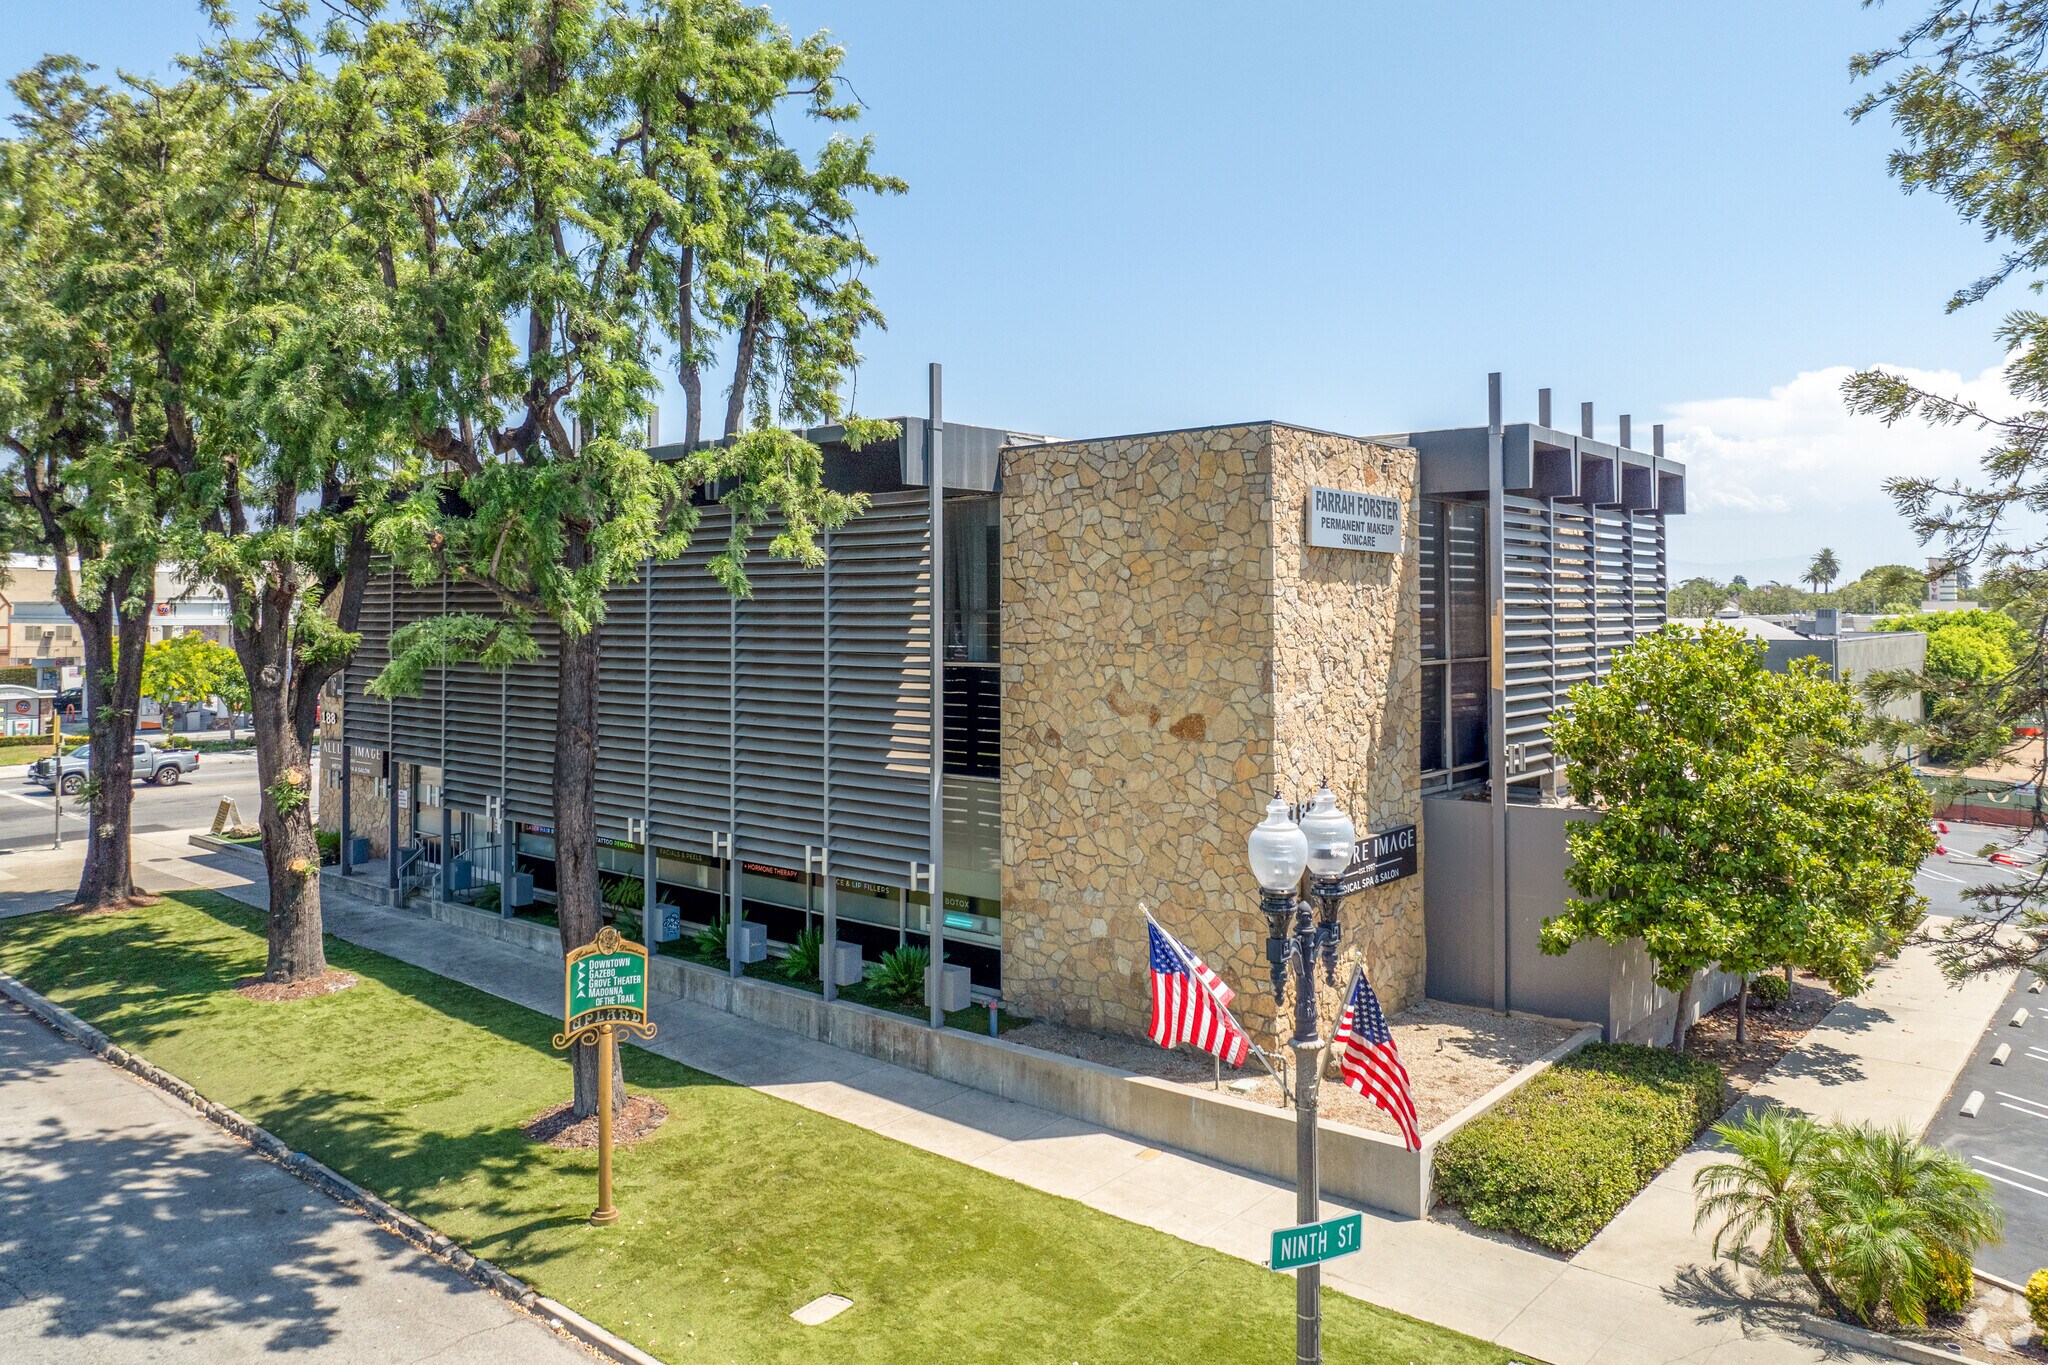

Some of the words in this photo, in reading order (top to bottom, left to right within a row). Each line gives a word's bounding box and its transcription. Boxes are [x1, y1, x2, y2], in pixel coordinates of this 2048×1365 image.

[1316, 490, 1354, 515] FARRAH
[1358, 497, 1398, 520] FORSTER
[1322, 517, 1365, 532] PERMANENT
[1367, 522, 1394, 535] MAKEUP
[1343, 534, 1375, 547] SKINCARE
[322, 711, 336, 724] 188
[323, 742, 342, 754] ALLU
[355, 746, 380, 760] IMAGE
[614, 841, 636, 850] REMOVAL
[1375, 829, 1414, 857] IMAGE
[660, 849, 680, 857] FACIALS
[686, 853, 702, 861] PEELS
[748, 864, 773, 873] HORMONE
[774, 868, 797, 877] THERAPY
[1344, 881, 1361, 893] DICAL
[1362, 876, 1374, 888] SPA
[1375, 875, 1379, 883] &
[1380, 868, 1399, 882] SALON
[864, 884, 890, 894] FILLERS
[945, 898, 969, 908] BOTOX
[589, 958, 630, 969] DOWNTOWN
[589, 969, 615, 978] GAZEBO
[589, 979, 611, 988] GROVE
[614, 975, 641, 986] THEATER
[589, 987, 623, 998] MADONNA
[596, 998, 604, 1006] OF
[605, 997, 615, 1005] THE
[617, 994, 635, 1003] TRAIL
[572, 1009, 640, 1030] UPLAND
[1281, 1230, 1327, 1261] NINTH
[1338, 1223, 1354, 1248] ST
